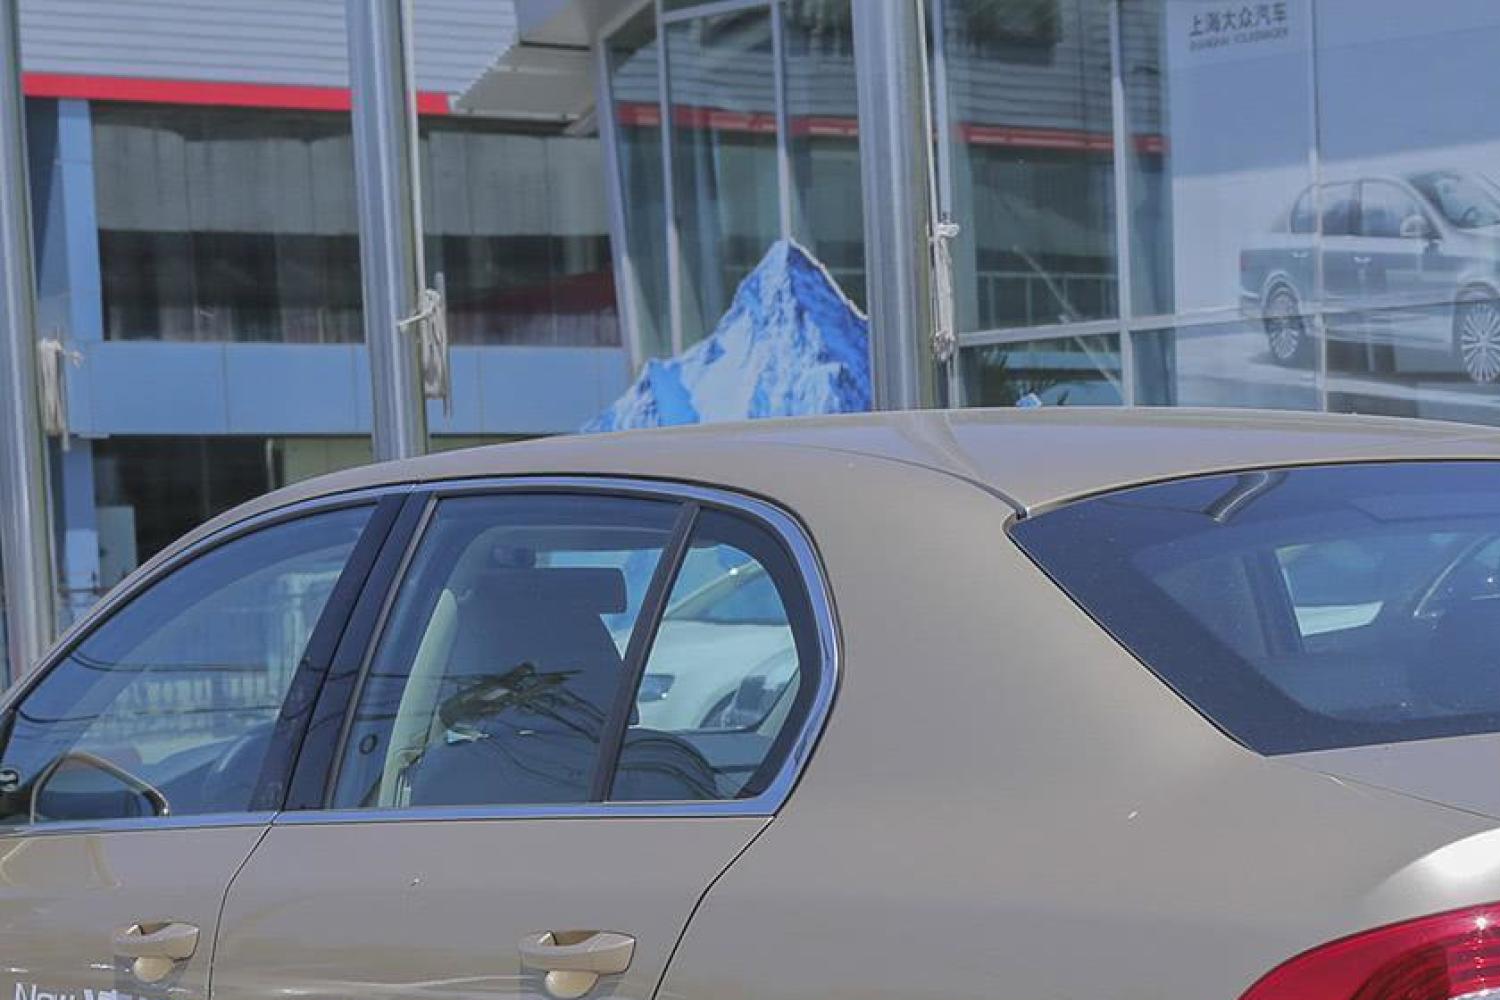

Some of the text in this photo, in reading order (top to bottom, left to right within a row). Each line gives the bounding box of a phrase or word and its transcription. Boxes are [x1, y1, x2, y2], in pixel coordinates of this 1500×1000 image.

[1189, 2, 1287, 36] 上海大众汽车
